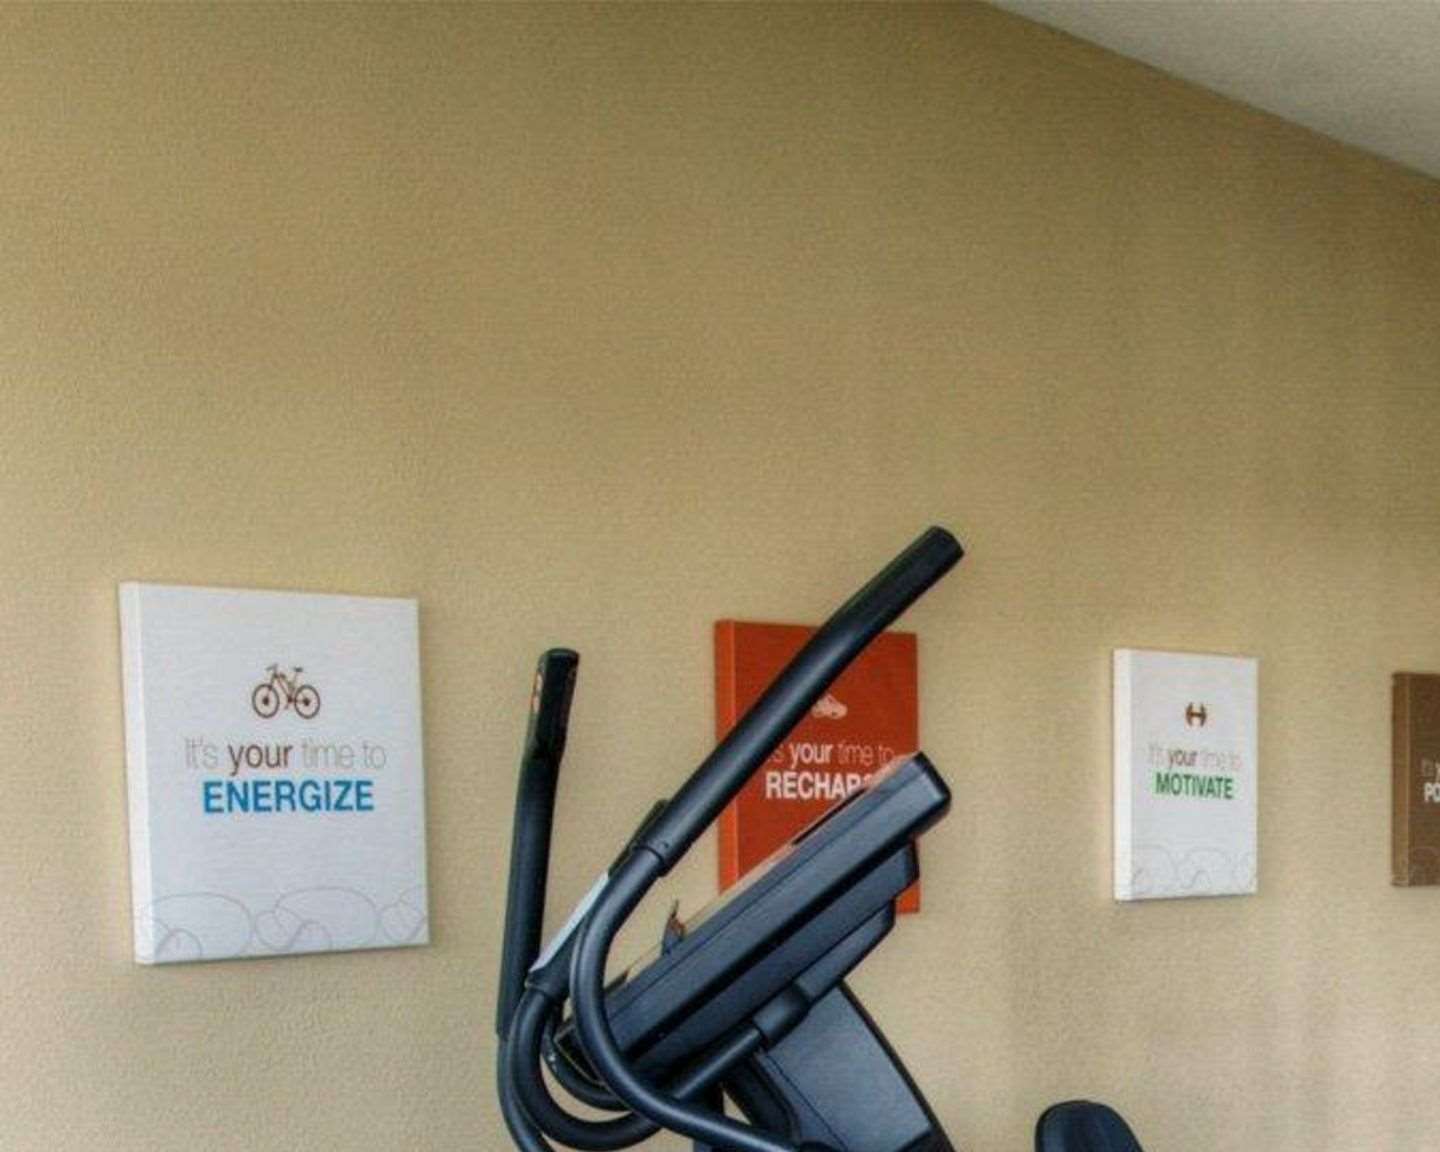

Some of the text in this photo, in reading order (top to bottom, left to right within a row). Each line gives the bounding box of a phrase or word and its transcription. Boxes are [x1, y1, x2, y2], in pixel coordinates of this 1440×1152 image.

[227, 743, 293, 776] your
[302, 739, 354, 769] time
[363, 741, 387, 769] to
[789, 742, 833, 769] your
[1168, 749, 1197, 770] your
[203, 780, 374, 813] ENERGIZE
[765, 771, 873, 799] RECHAR
[1155, 772, 1233, 799] MOTIVATE
